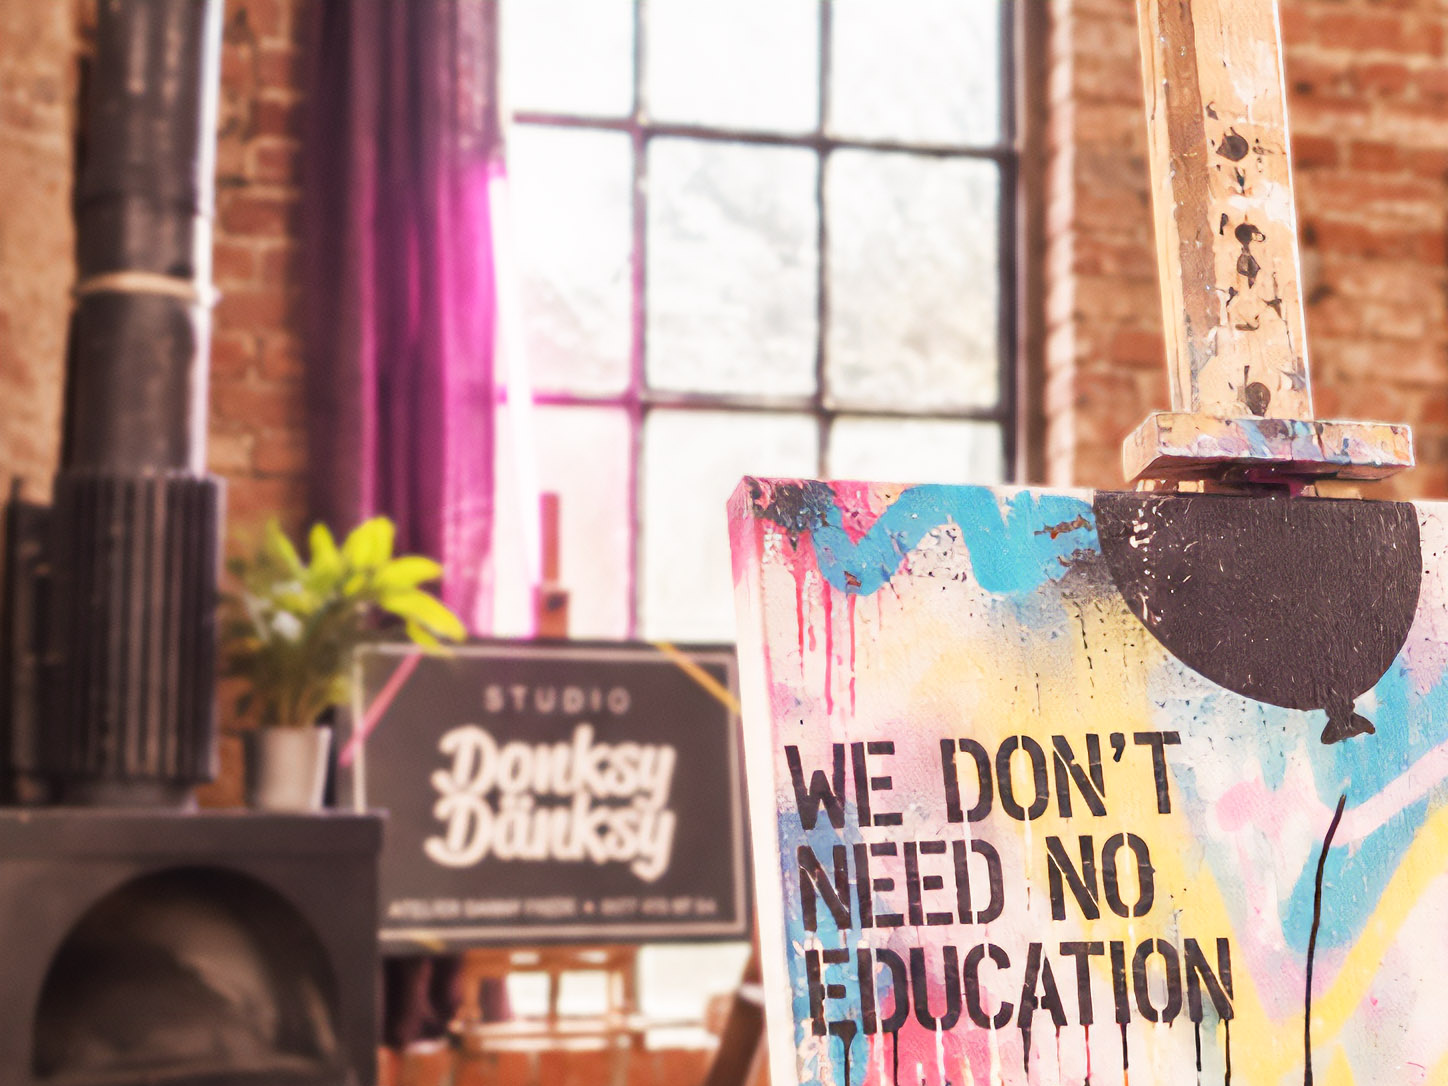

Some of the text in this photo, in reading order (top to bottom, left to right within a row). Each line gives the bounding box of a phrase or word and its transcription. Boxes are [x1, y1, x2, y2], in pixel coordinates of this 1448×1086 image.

[484, 685, 632, 714] STUDIO
[430, 722, 677, 806] Donksy
[785, 742, 903, 830] WE
[797, 832, 1156, 932] NEED NO
[804, 937, 1235, 1037] EDUCATION
